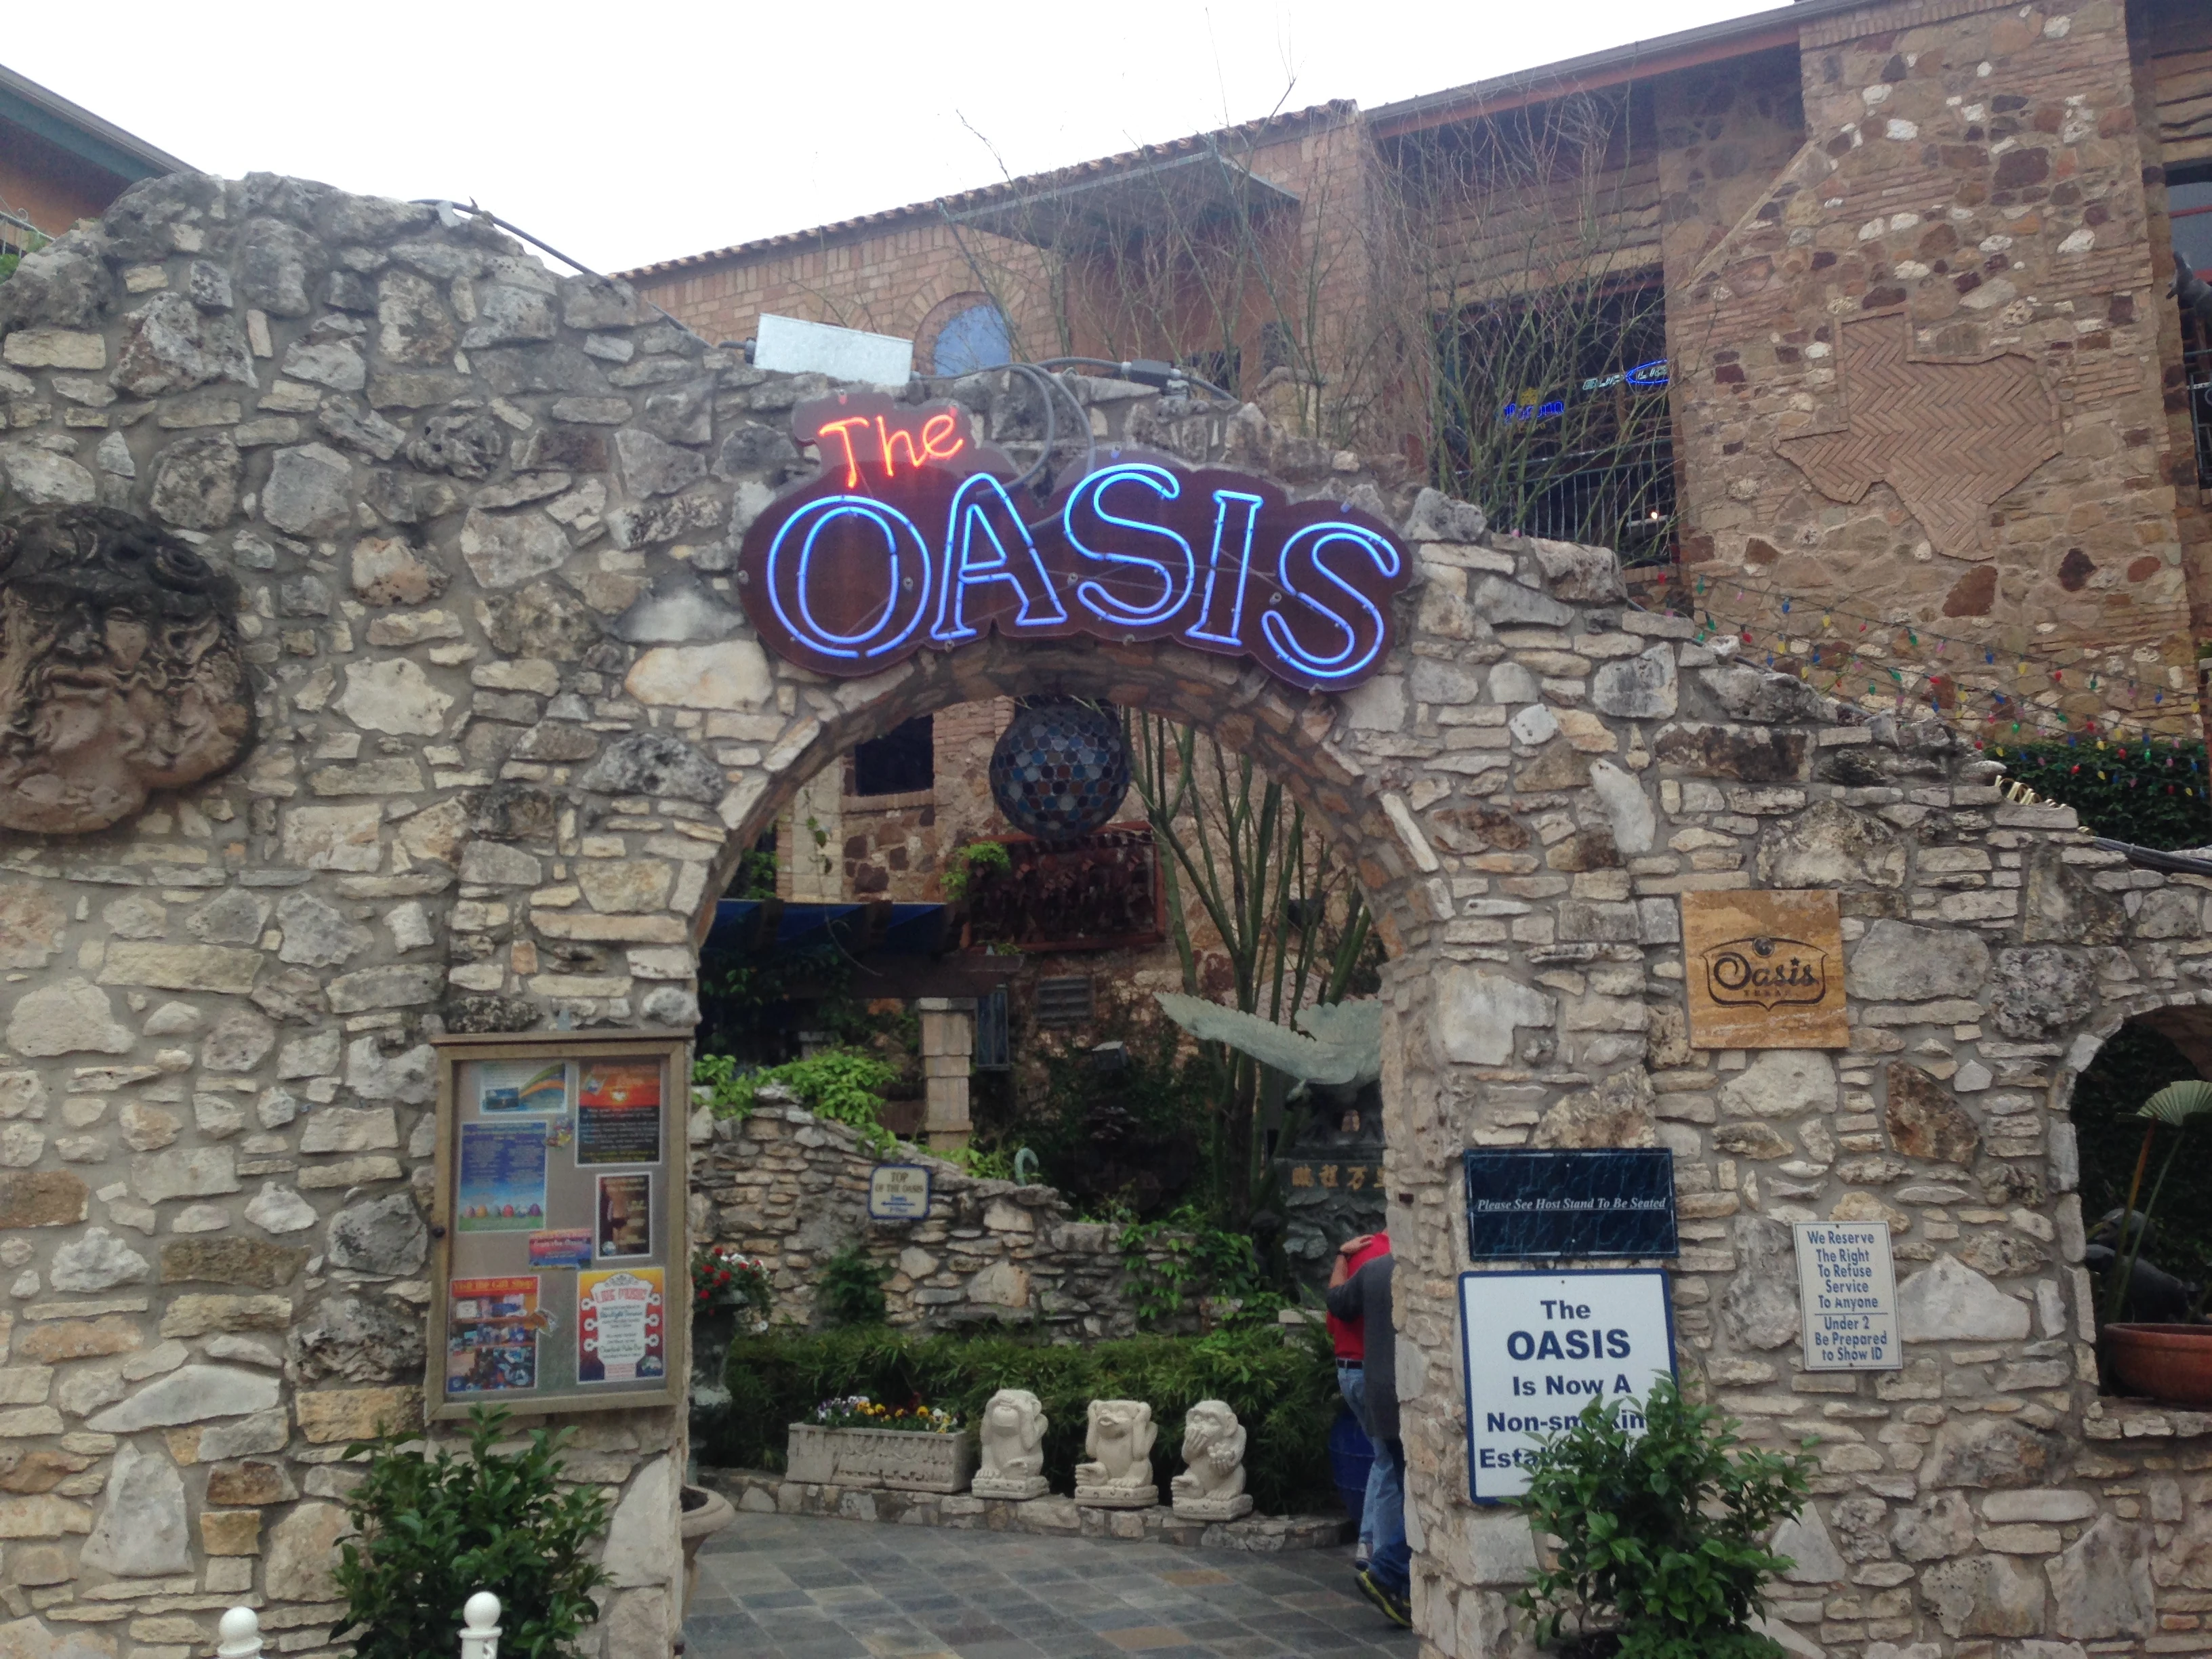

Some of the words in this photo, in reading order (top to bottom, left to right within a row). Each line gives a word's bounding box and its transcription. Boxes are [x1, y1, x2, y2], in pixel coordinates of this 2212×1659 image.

[819, 413, 965, 488] The
[766, 463, 1401, 678] OASIS
[1713, 951, 1820, 991] Oasis
[890, 1172, 908, 1183] TOP
[1477, 1198, 1511, 1210] Please
[1513, 1198, 1533, 1210] See
[1536, 1198, 1561, 1210] Host
[1563, 1197, 1594, 1209] Stand
[1597, 1197, 1610, 1208] To
[1613, 1197, 1628, 1208] Be
[1630, 1197, 1666, 1208] Seated
[1806, 1231, 1825, 1244] We
[1828, 1231, 1875, 1244] Reserve
[1816, 1249, 1837, 1262] The
[1839, 1248, 1870, 1265] Right
[1817, 1264, 1830, 1277] To
[1833, 1263, 1872, 1277] Refuse
[1825, 1279, 1869, 1293] Service
[1540, 1300, 1591, 1319] The
[1818, 1295, 1831, 1309] To
[1835, 1297, 1879, 1312] Anyone
[1824, 1315, 1859, 1330] Under
[1507, 1328, 1631, 1361] OASIS
[1814, 1332, 1829, 1346] Be
[1832, 1330, 1887, 1349] Prepared
[1822, 1349, 1834, 1361] to
[1837, 1347, 1868, 1361] Show
[1871, 1347, 1883, 1360] ID
[1513, 1376, 1536, 1396] Is
[1545, 1375, 1604, 1395] Now
[1613, 1374, 1633, 1393] A
